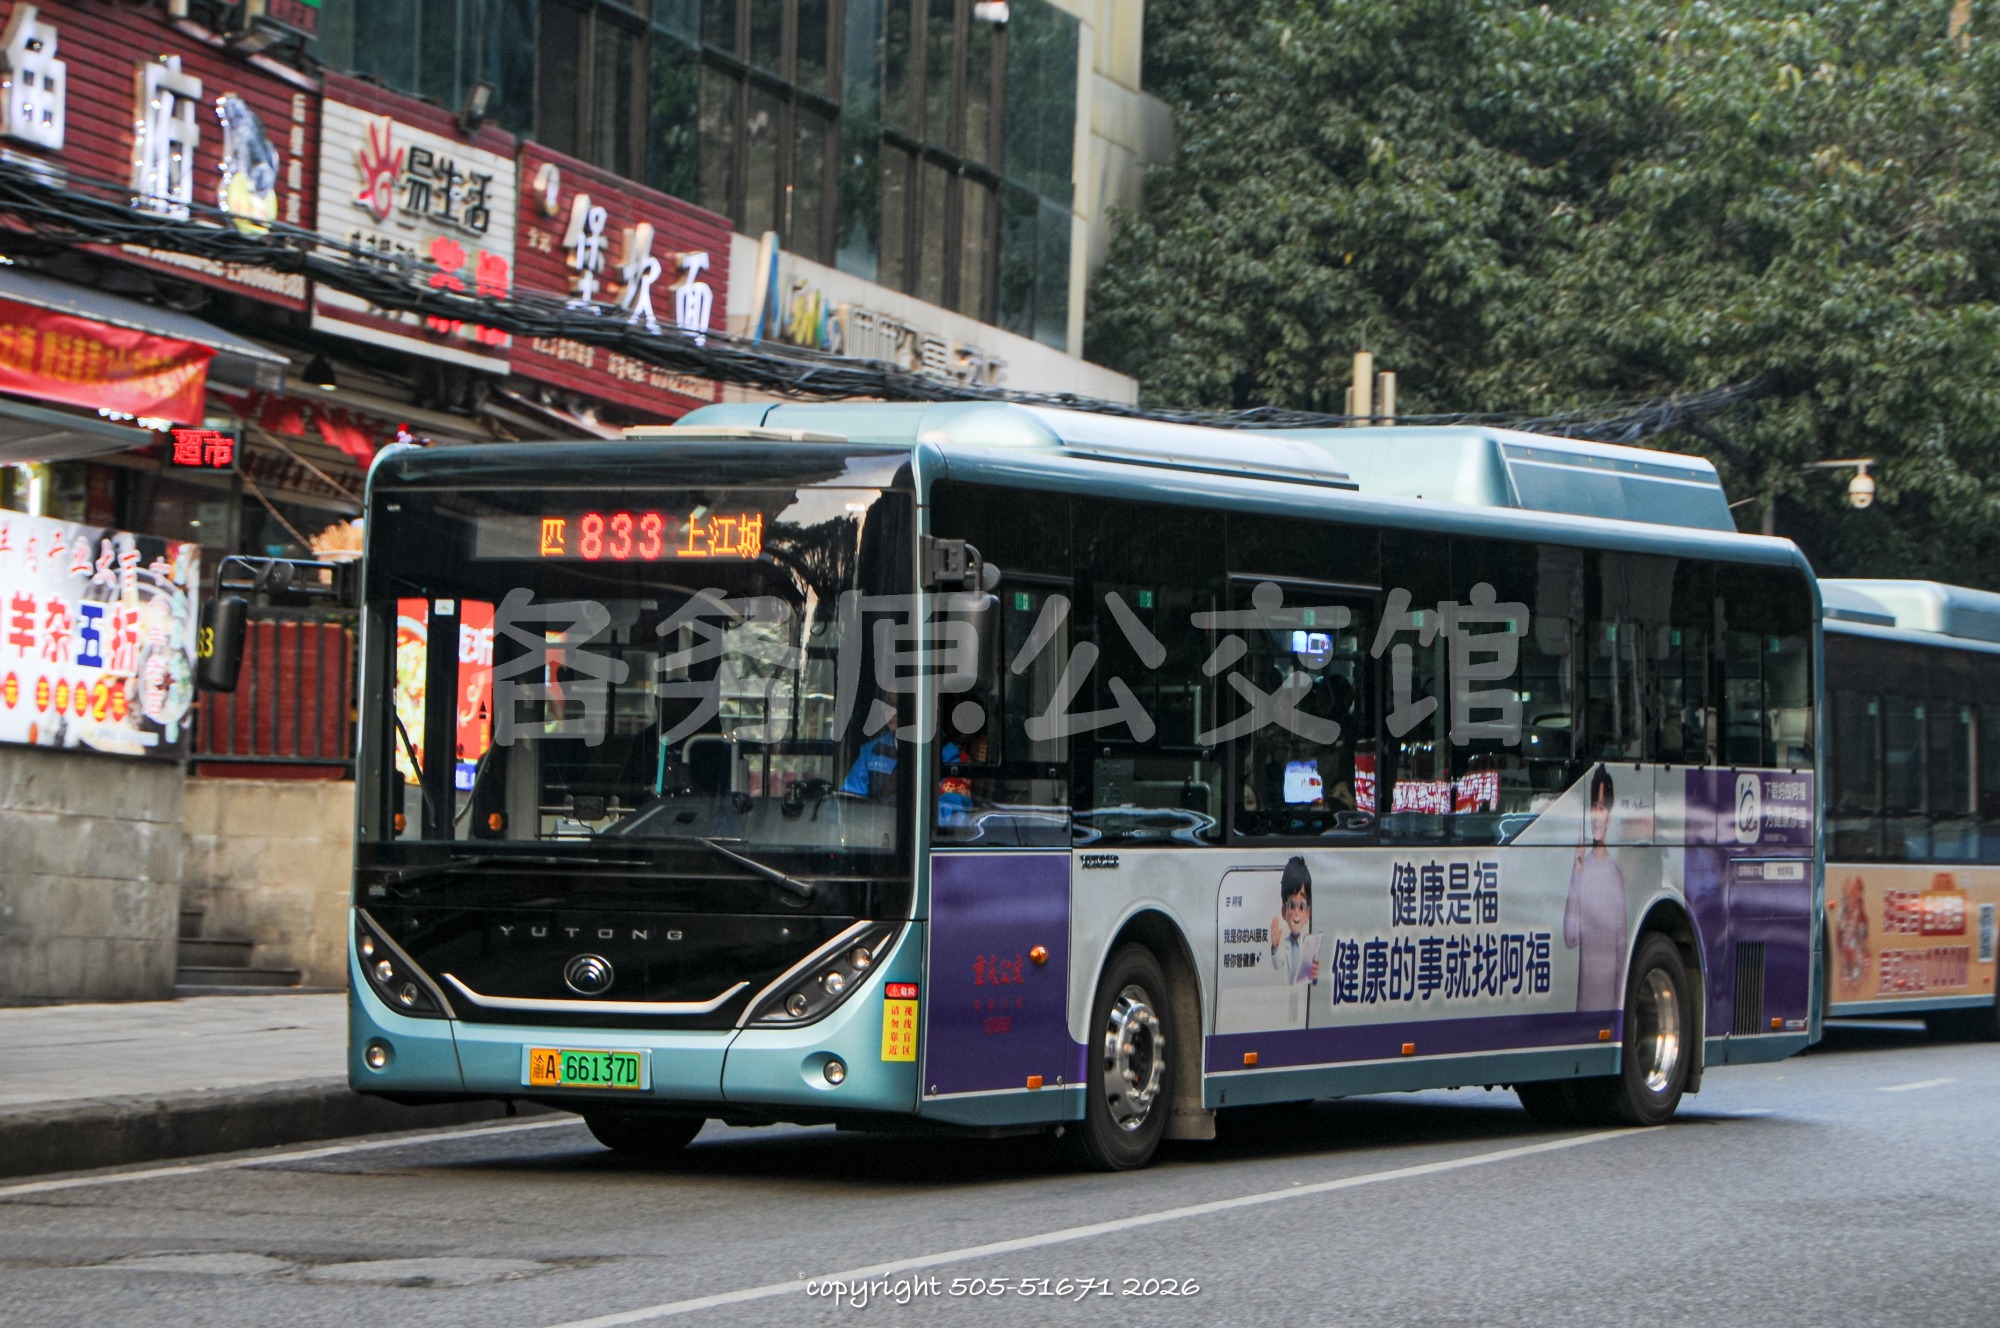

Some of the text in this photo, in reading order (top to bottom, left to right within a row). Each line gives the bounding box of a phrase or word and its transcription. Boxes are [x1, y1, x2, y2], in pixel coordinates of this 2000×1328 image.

[171, 428, 235, 468] 超市
[580, 512, 663, 560] 833
[677, 512, 763, 559] 上江城
[1390, 860, 1499, 928] 健康是福
[499, 925, 683, 941] YUTONG
[1223, 928, 1269, 944] 我是你的AI朋友
[1331, 931, 1551, 1006] 健康的事就找阿福
[900, 985, 916, 997] 危险
[888, 1004, 900, 1056] 请勿靠近
[902, 1004, 913, 1056] 视线盲区
[532, 1053, 638, 1084] 渝A 66137D
